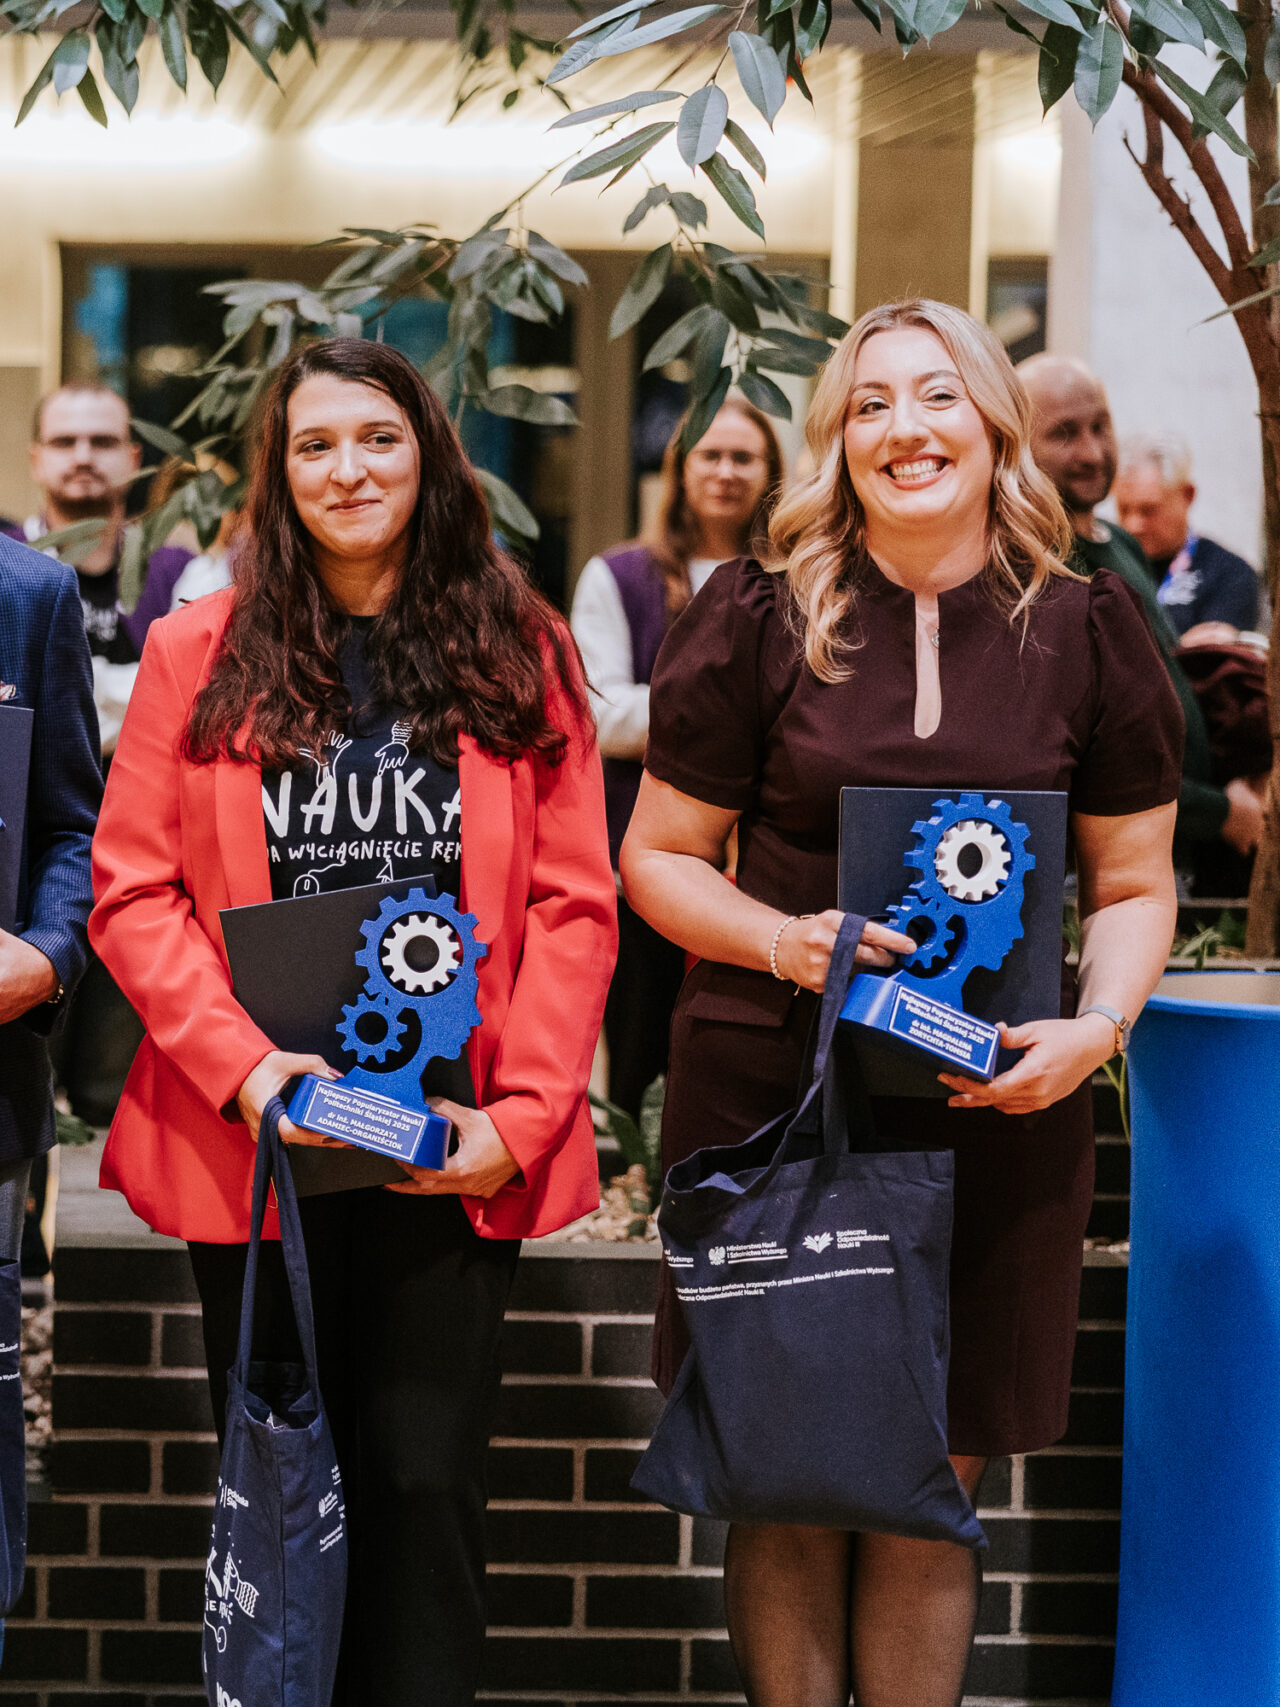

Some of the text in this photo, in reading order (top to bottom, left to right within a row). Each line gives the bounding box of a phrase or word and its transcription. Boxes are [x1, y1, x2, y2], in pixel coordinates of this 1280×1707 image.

[268, 846, 281, 863] A
[318, 1087, 421, 1127] Najlepszy Popularyzator Nauki
[323, 1097, 364, 1116] Politechniki
[392, 1120, 410, 1132] 2025
[327, 1111, 336, 1119] dr
[350, 1118, 398, 1140] MAŁGORZATA
